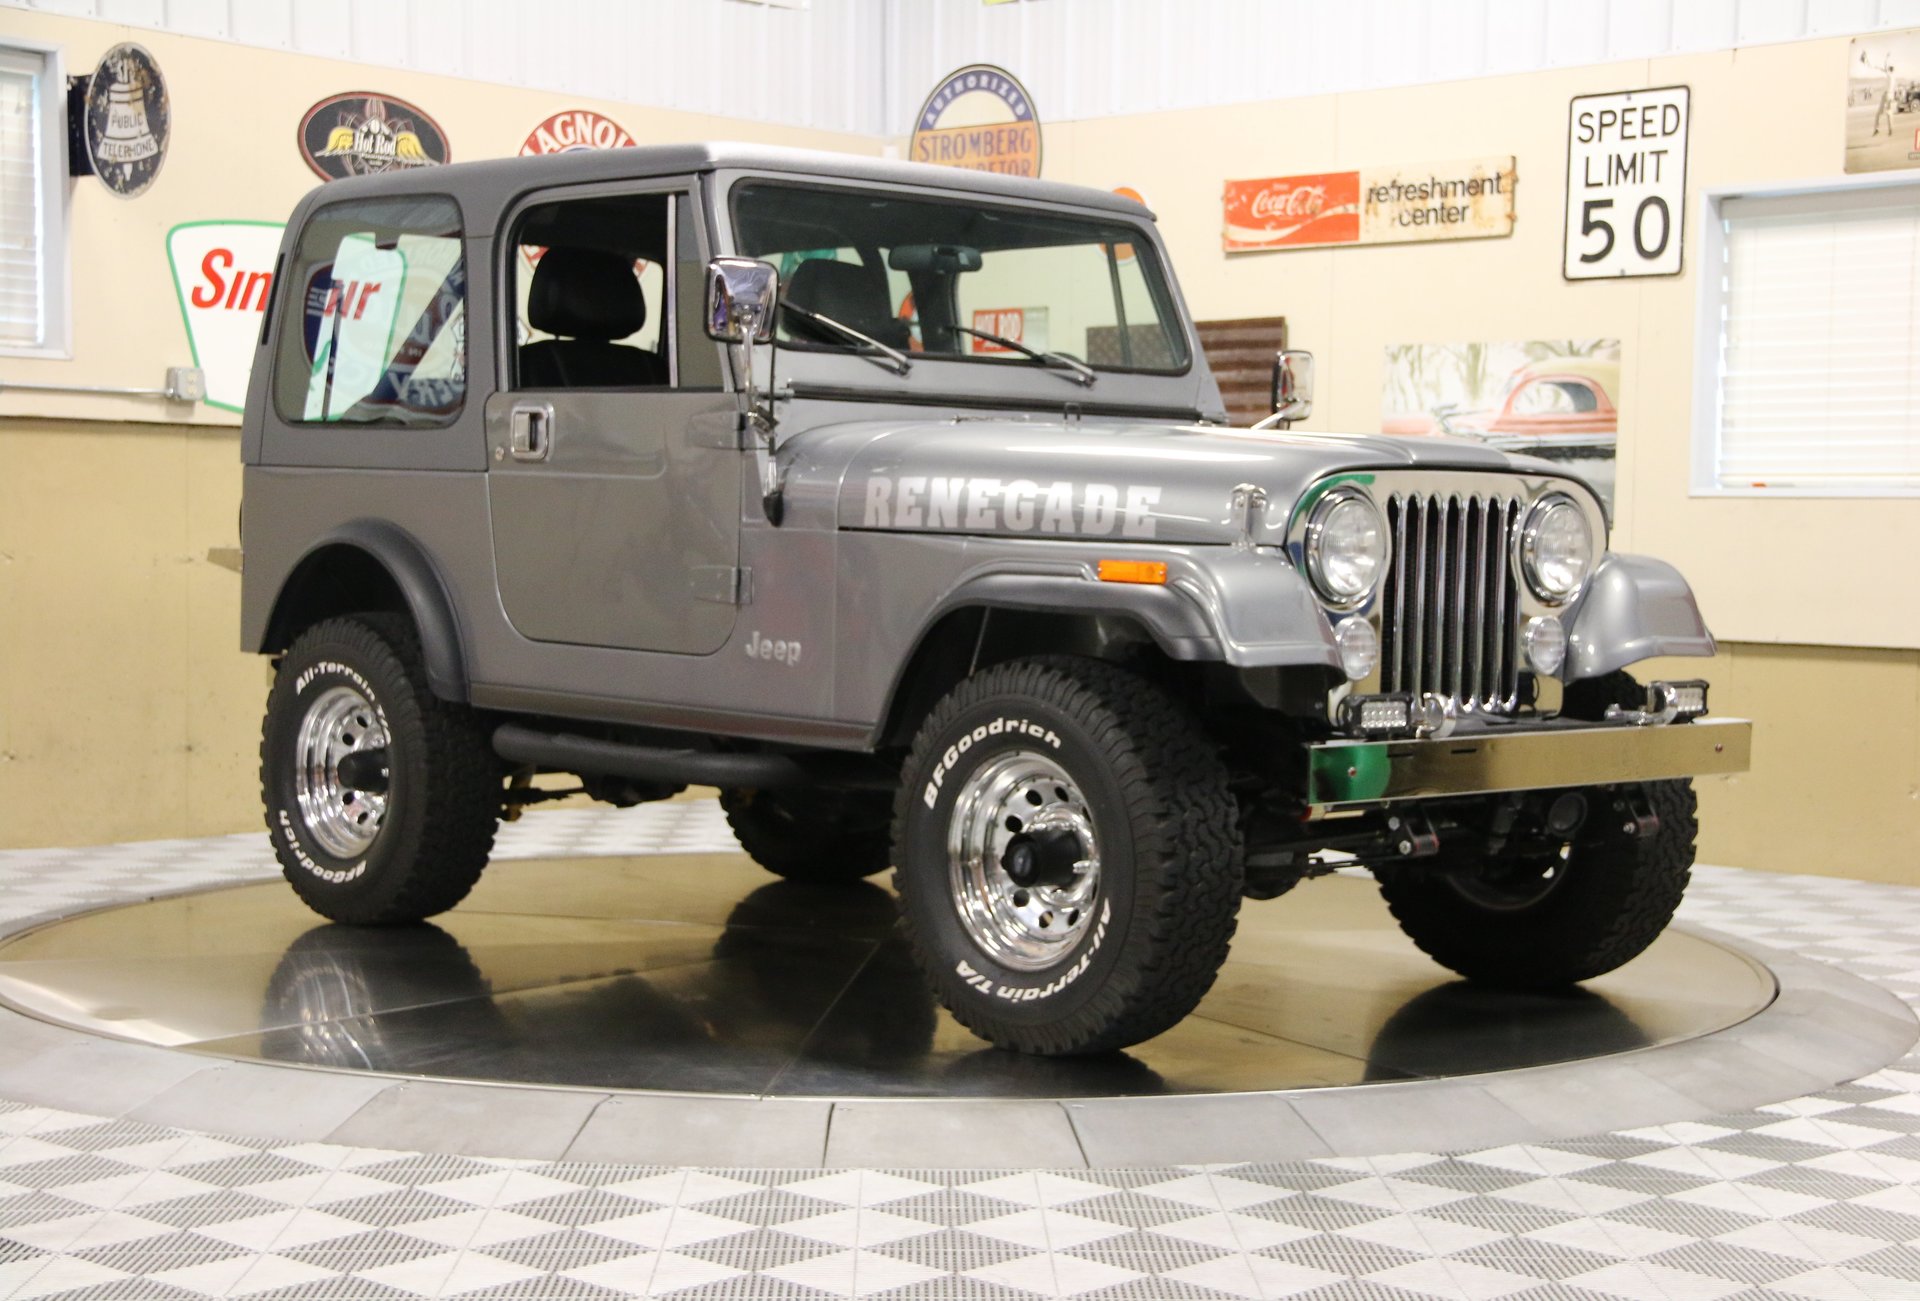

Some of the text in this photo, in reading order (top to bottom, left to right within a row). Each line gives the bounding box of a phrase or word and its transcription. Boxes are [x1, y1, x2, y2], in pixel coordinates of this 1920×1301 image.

[925, 73, 1026, 125] AUTHORIZED
[110, 112, 144, 129] PUBLIC
[1577, 103, 1680, 143] SPEED
[103, 139, 156, 158] TELEPHONE
[354, 129, 397, 156] Hot Rod
[919, 127, 1032, 163] STROMBERG
[1367, 172, 1503, 203] refreshment
[1584, 149, 1669, 188] LIMIT
[1399, 203, 1470, 227] center
[1579, 195, 1671, 264] 50
[863, 476, 1163, 538] RENEGADE
[745, 630, 802, 668] Jeep
[923, 717, 1062, 810] BFGoodrich
[279, 809, 367, 884] BFGoodrich
[955, 897, 1111, 1003] All-Terrain T/A
